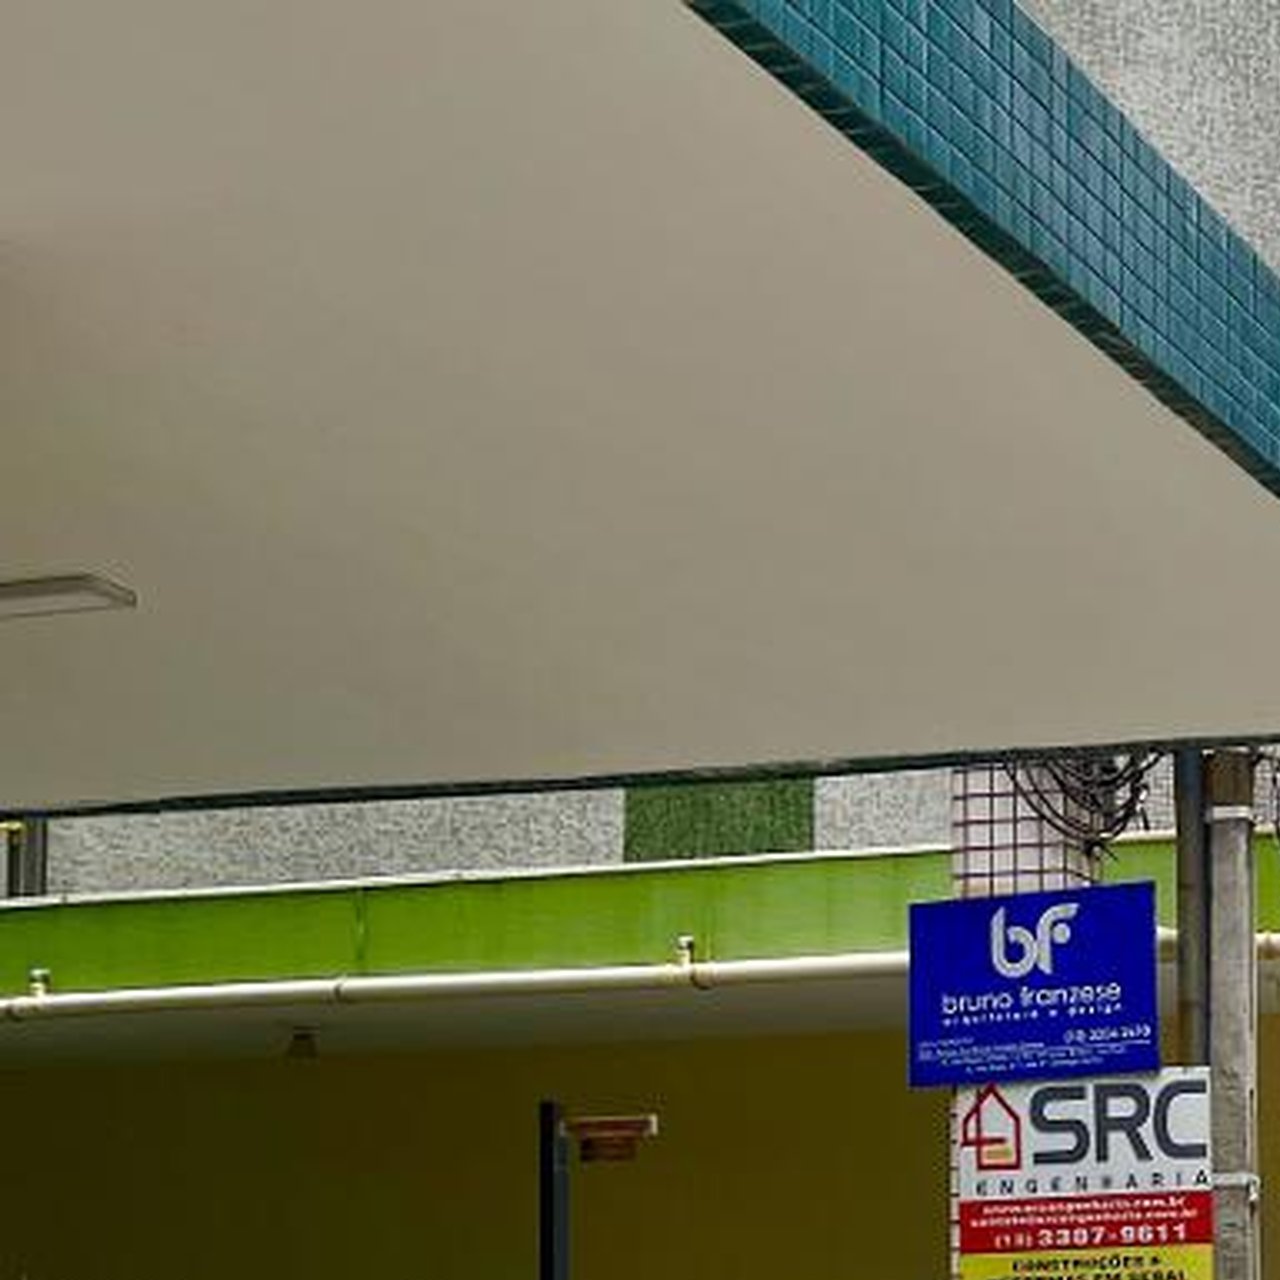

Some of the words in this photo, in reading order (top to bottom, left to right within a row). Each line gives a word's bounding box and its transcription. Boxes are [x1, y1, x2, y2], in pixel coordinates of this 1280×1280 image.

[942, 992, 1014, 1014] bruno
[1029, 1078, 1207, 1165] SRC
[975, 1169, 1210, 1196] ENGENHARIA
